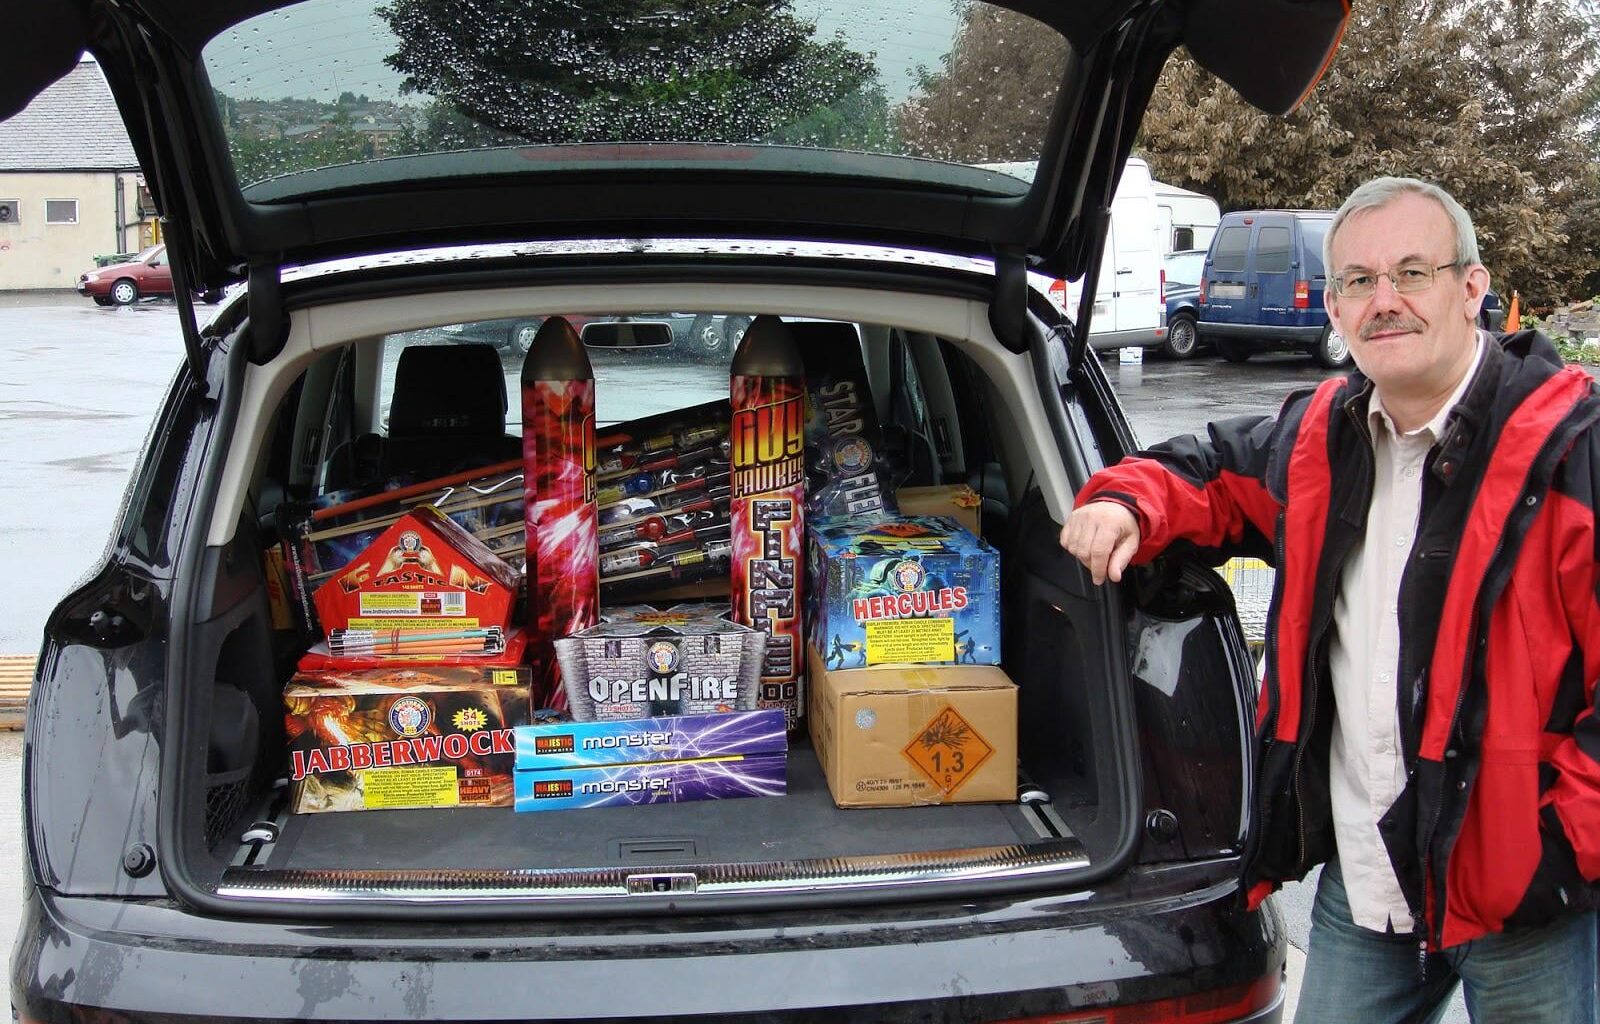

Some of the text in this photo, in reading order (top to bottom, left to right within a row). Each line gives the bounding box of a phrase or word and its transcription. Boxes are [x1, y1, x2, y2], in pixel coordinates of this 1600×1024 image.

[820, 381, 864, 437] STAR
[735, 402, 804, 467] GUY
[372, 571, 450, 588] TASTIC
[853, 586, 968, 621] HERCULES
[588, 674, 739, 704] OPENFIRE
[758, 682, 798, 701] 00
[463, 711, 477, 720] 54
[582, 731, 673, 750] monster
[292, 729, 516, 781] JABBERWOCK
[931, 751, 965, 773] 1.3
[581, 778, 673, 794] monster
[945, 775, 952, 783] G
[460, 786, 490, 794] HEAVY
